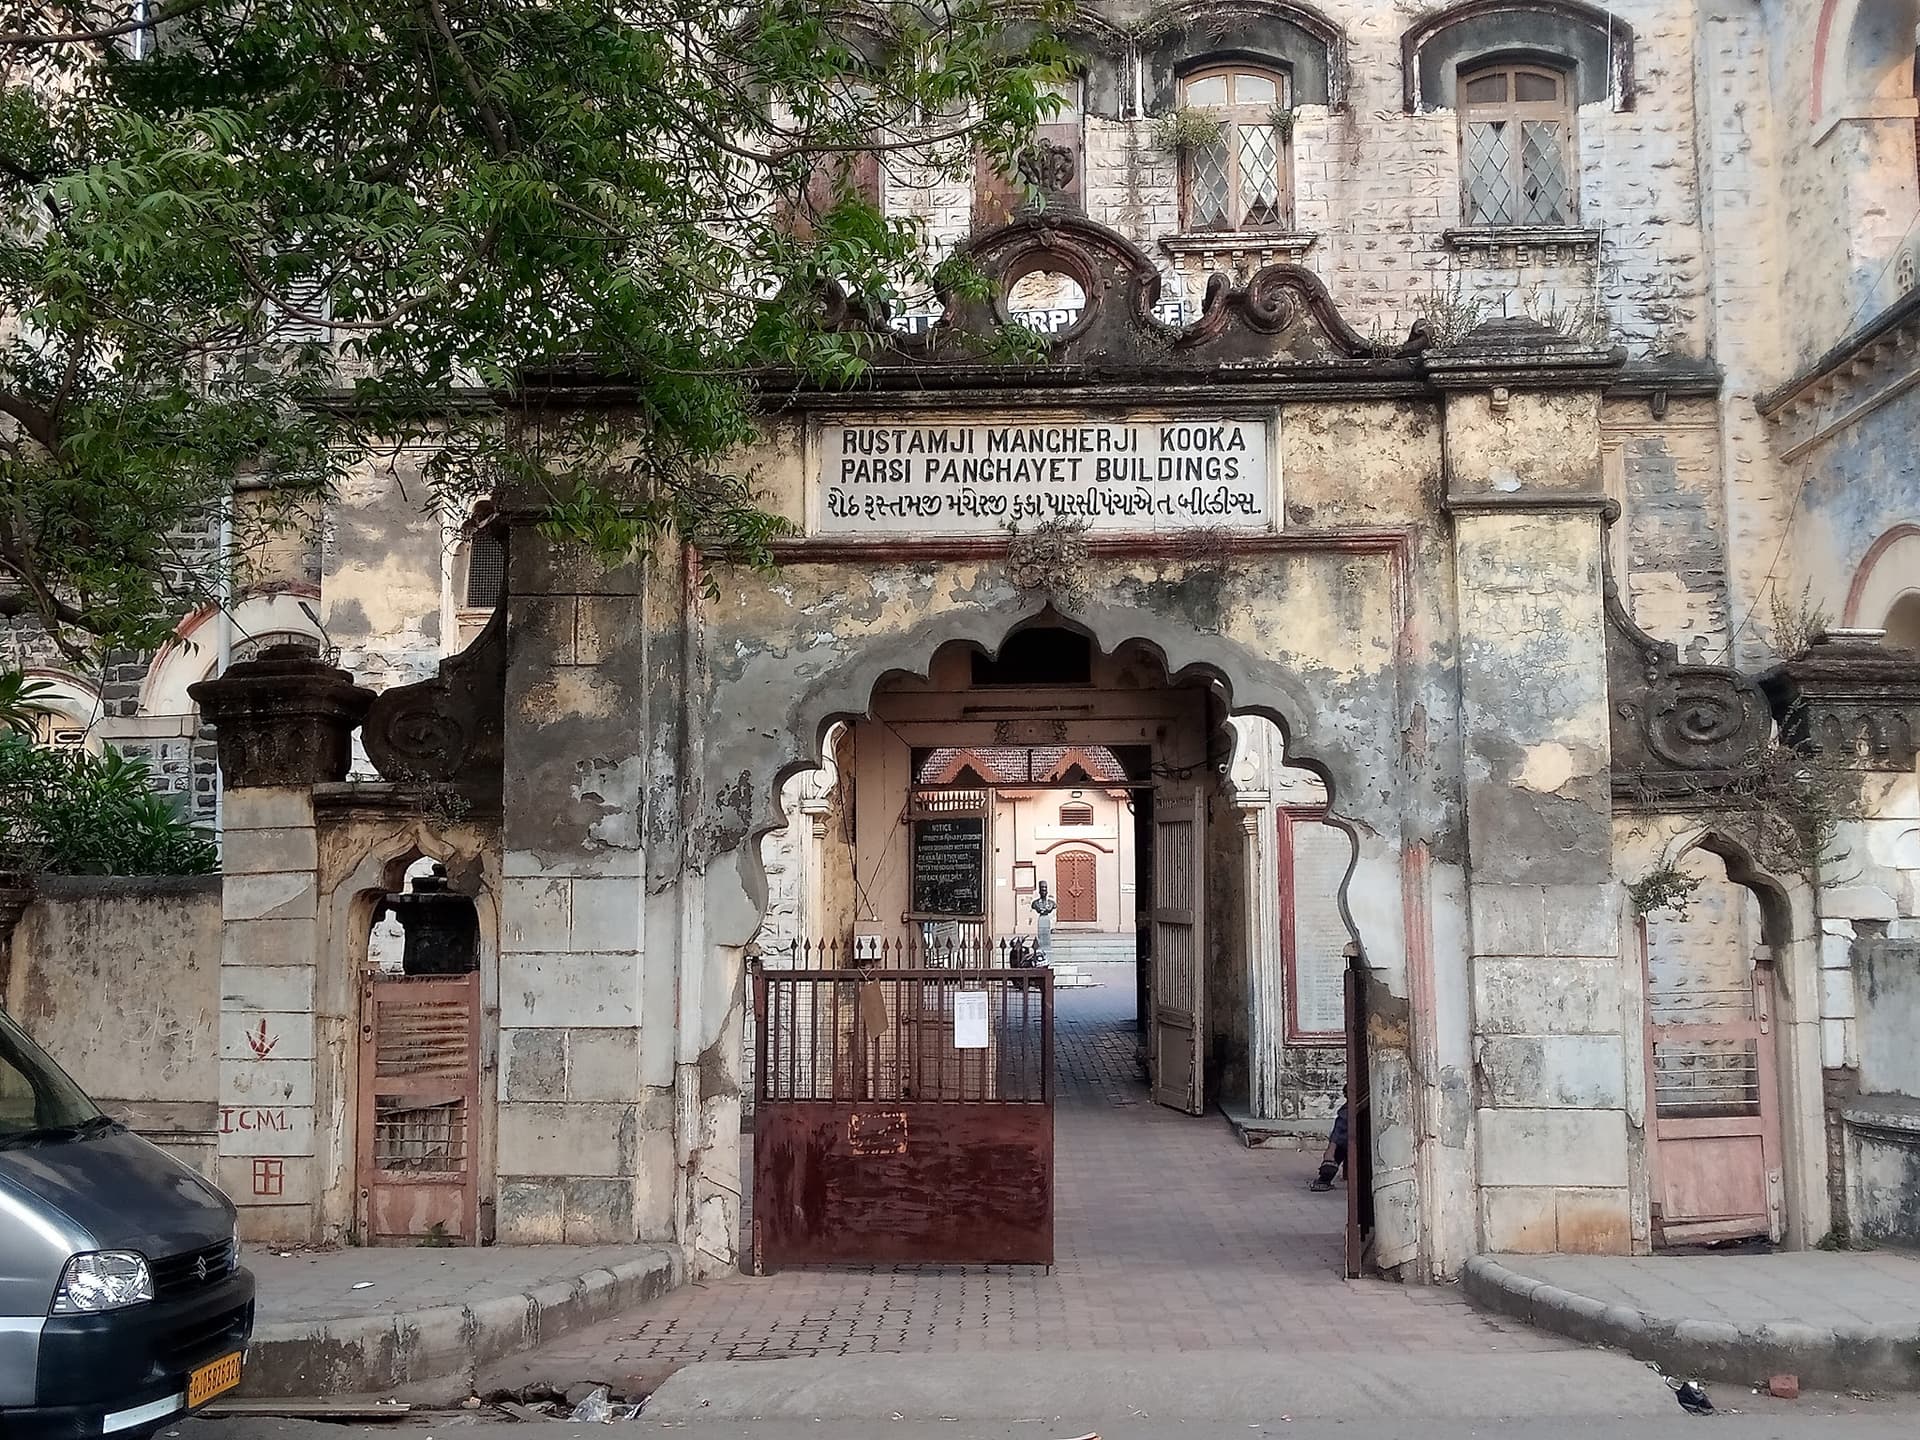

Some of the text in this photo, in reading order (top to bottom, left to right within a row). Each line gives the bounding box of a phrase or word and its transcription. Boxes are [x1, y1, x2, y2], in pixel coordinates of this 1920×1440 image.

[842, 427, 1247, 455] RUSTAMJI MANCHERJI KOOKA
[840, 458, 911, 483] PARSI
[925, 458, 1083, 483] PANCHAYET
